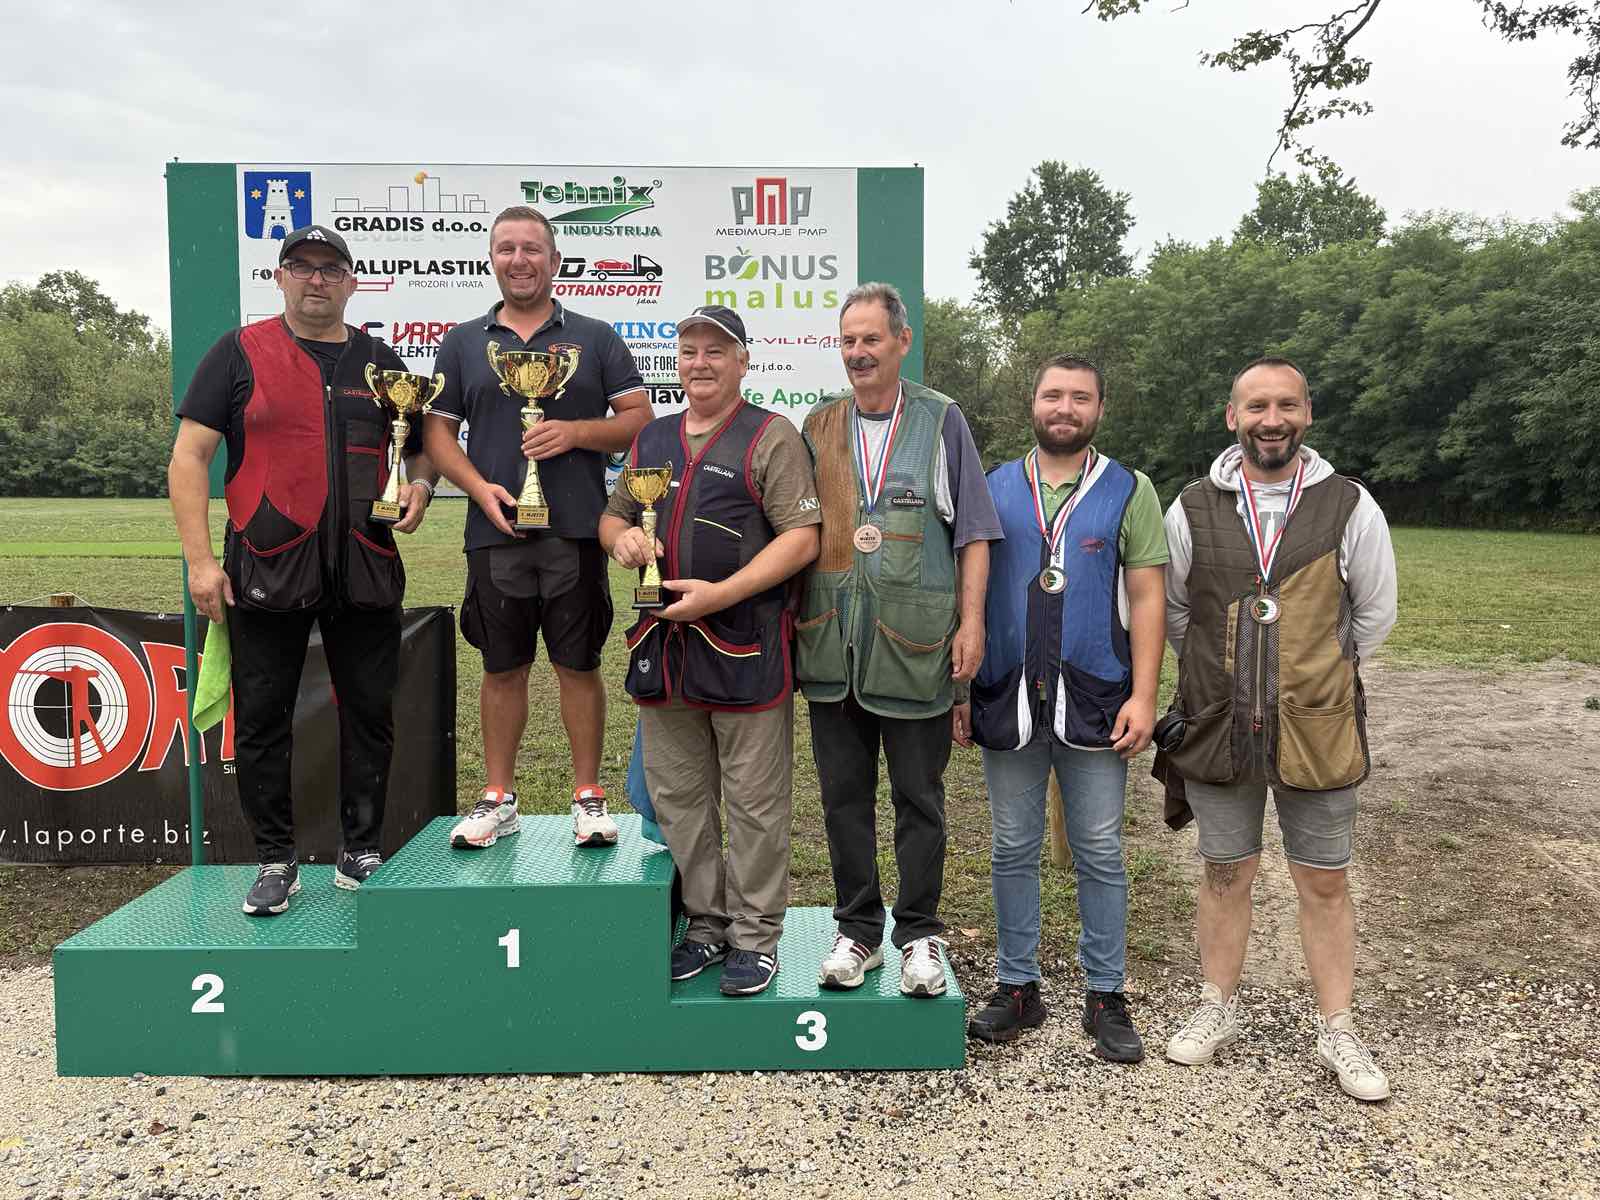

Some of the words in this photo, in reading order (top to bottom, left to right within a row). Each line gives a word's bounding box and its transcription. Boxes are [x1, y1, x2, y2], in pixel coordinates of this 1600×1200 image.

[520, 176, 655, 204] Tehnix
[334, 216, 424, 232] GRADIS
[431, 218, 488, 232] d.o.o.
[563, 225, 661, 237] INDUSTRIJA
[798, 228, 828, 236] PMP
[353, 260, 491, 276] ALUPLASTIK
[705, 247, 838, 280] BONUS
[408, 280, 448, 289] PROZORI
[450, 280, 454, 289] I
[456, 280, 484, 289] VRATA
[552, 284, 662, 297] OTRANSPORTI
[705, 282, 839, 309] malus
[391, 345, 441, 358] ELEKTR
[627, 342, 678, 350] WORKSPACE
[653, 355, 678, 371] FORE
[743, 388, 764, 405] fe
[498, 928, 521, 968] 1
[191, 973, 225, 1013] 2
[795, 1010, 828, 1051] 3
